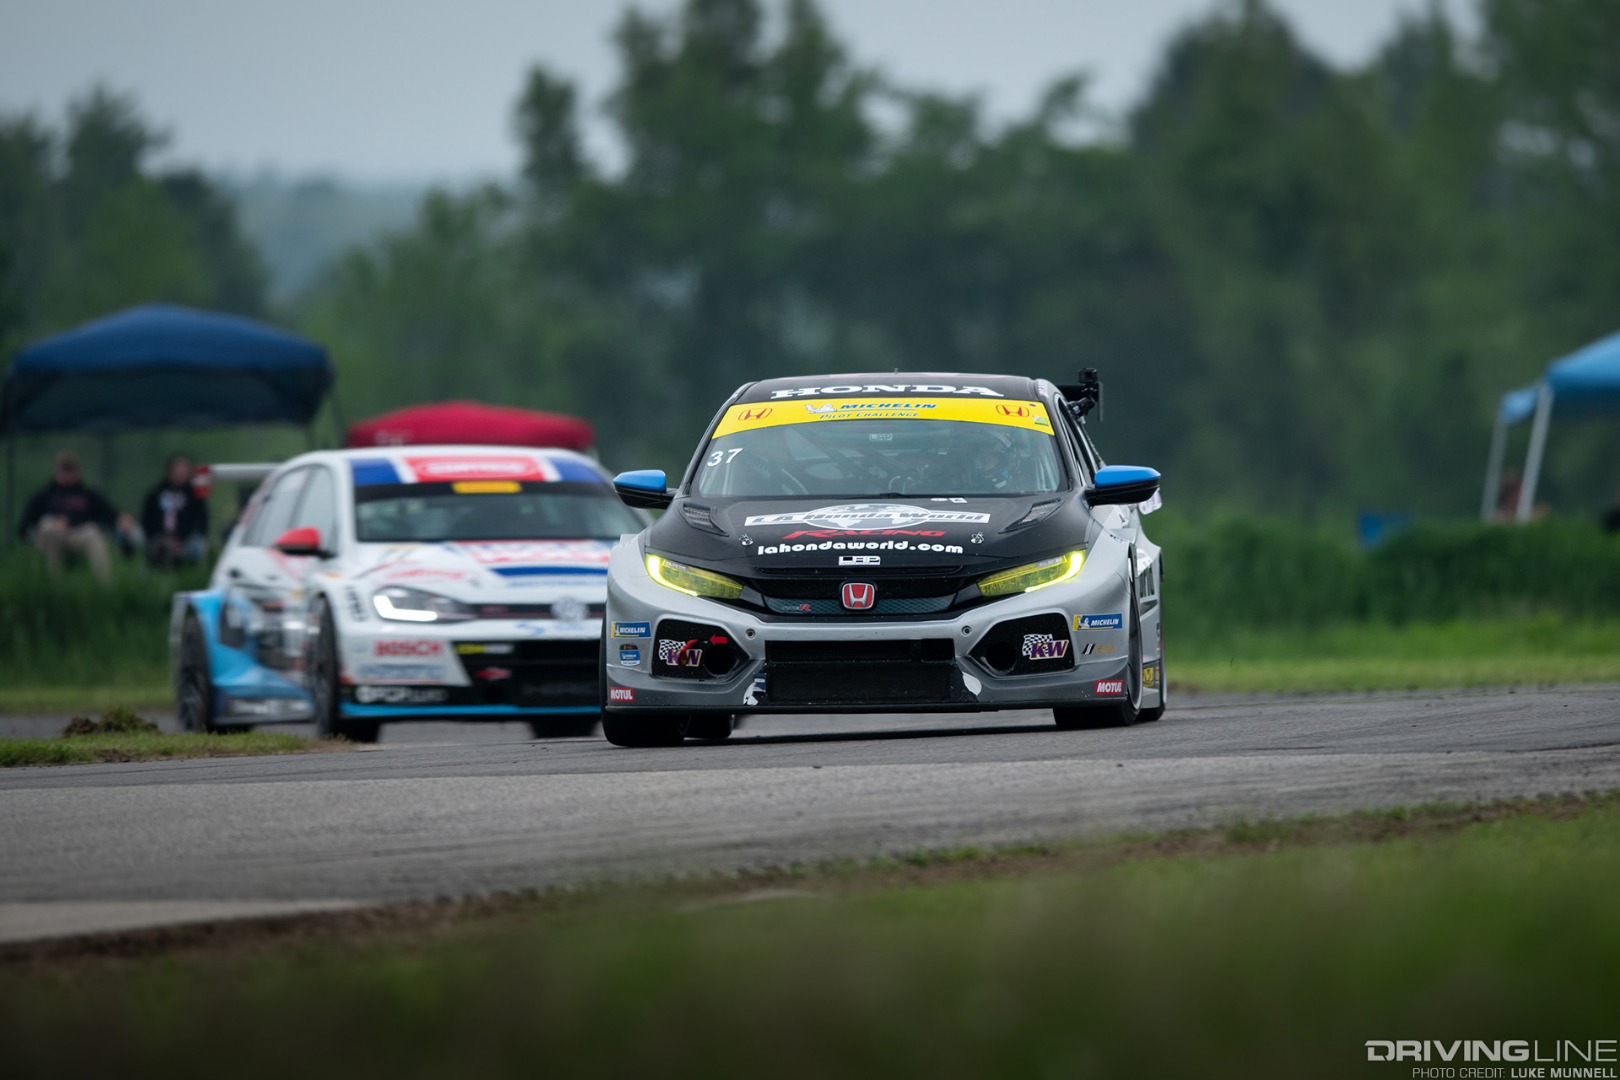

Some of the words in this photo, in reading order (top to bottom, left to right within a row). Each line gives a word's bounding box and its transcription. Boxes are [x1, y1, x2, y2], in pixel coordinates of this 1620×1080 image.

[770, 384, 1004, 399] HONDA
[840, 402, 937, 410] MICHELIN
[707, 447, 743, 467] 37
[802, 512, 895, 521] Honda
[899, 511, 984, 521] World
[782, 529, 947, 540] RACING
[758, 540, 964, 556] lahondaworld.com
[1090, 618, 1120, 627] MICHELIN
[619, 626, 646, 634] MICHELIN
[1030, 640, 1069, 660] KW
[1096, 681, 1122, 693] MOTUL
[610, 689, 633, 700] MOTUL
